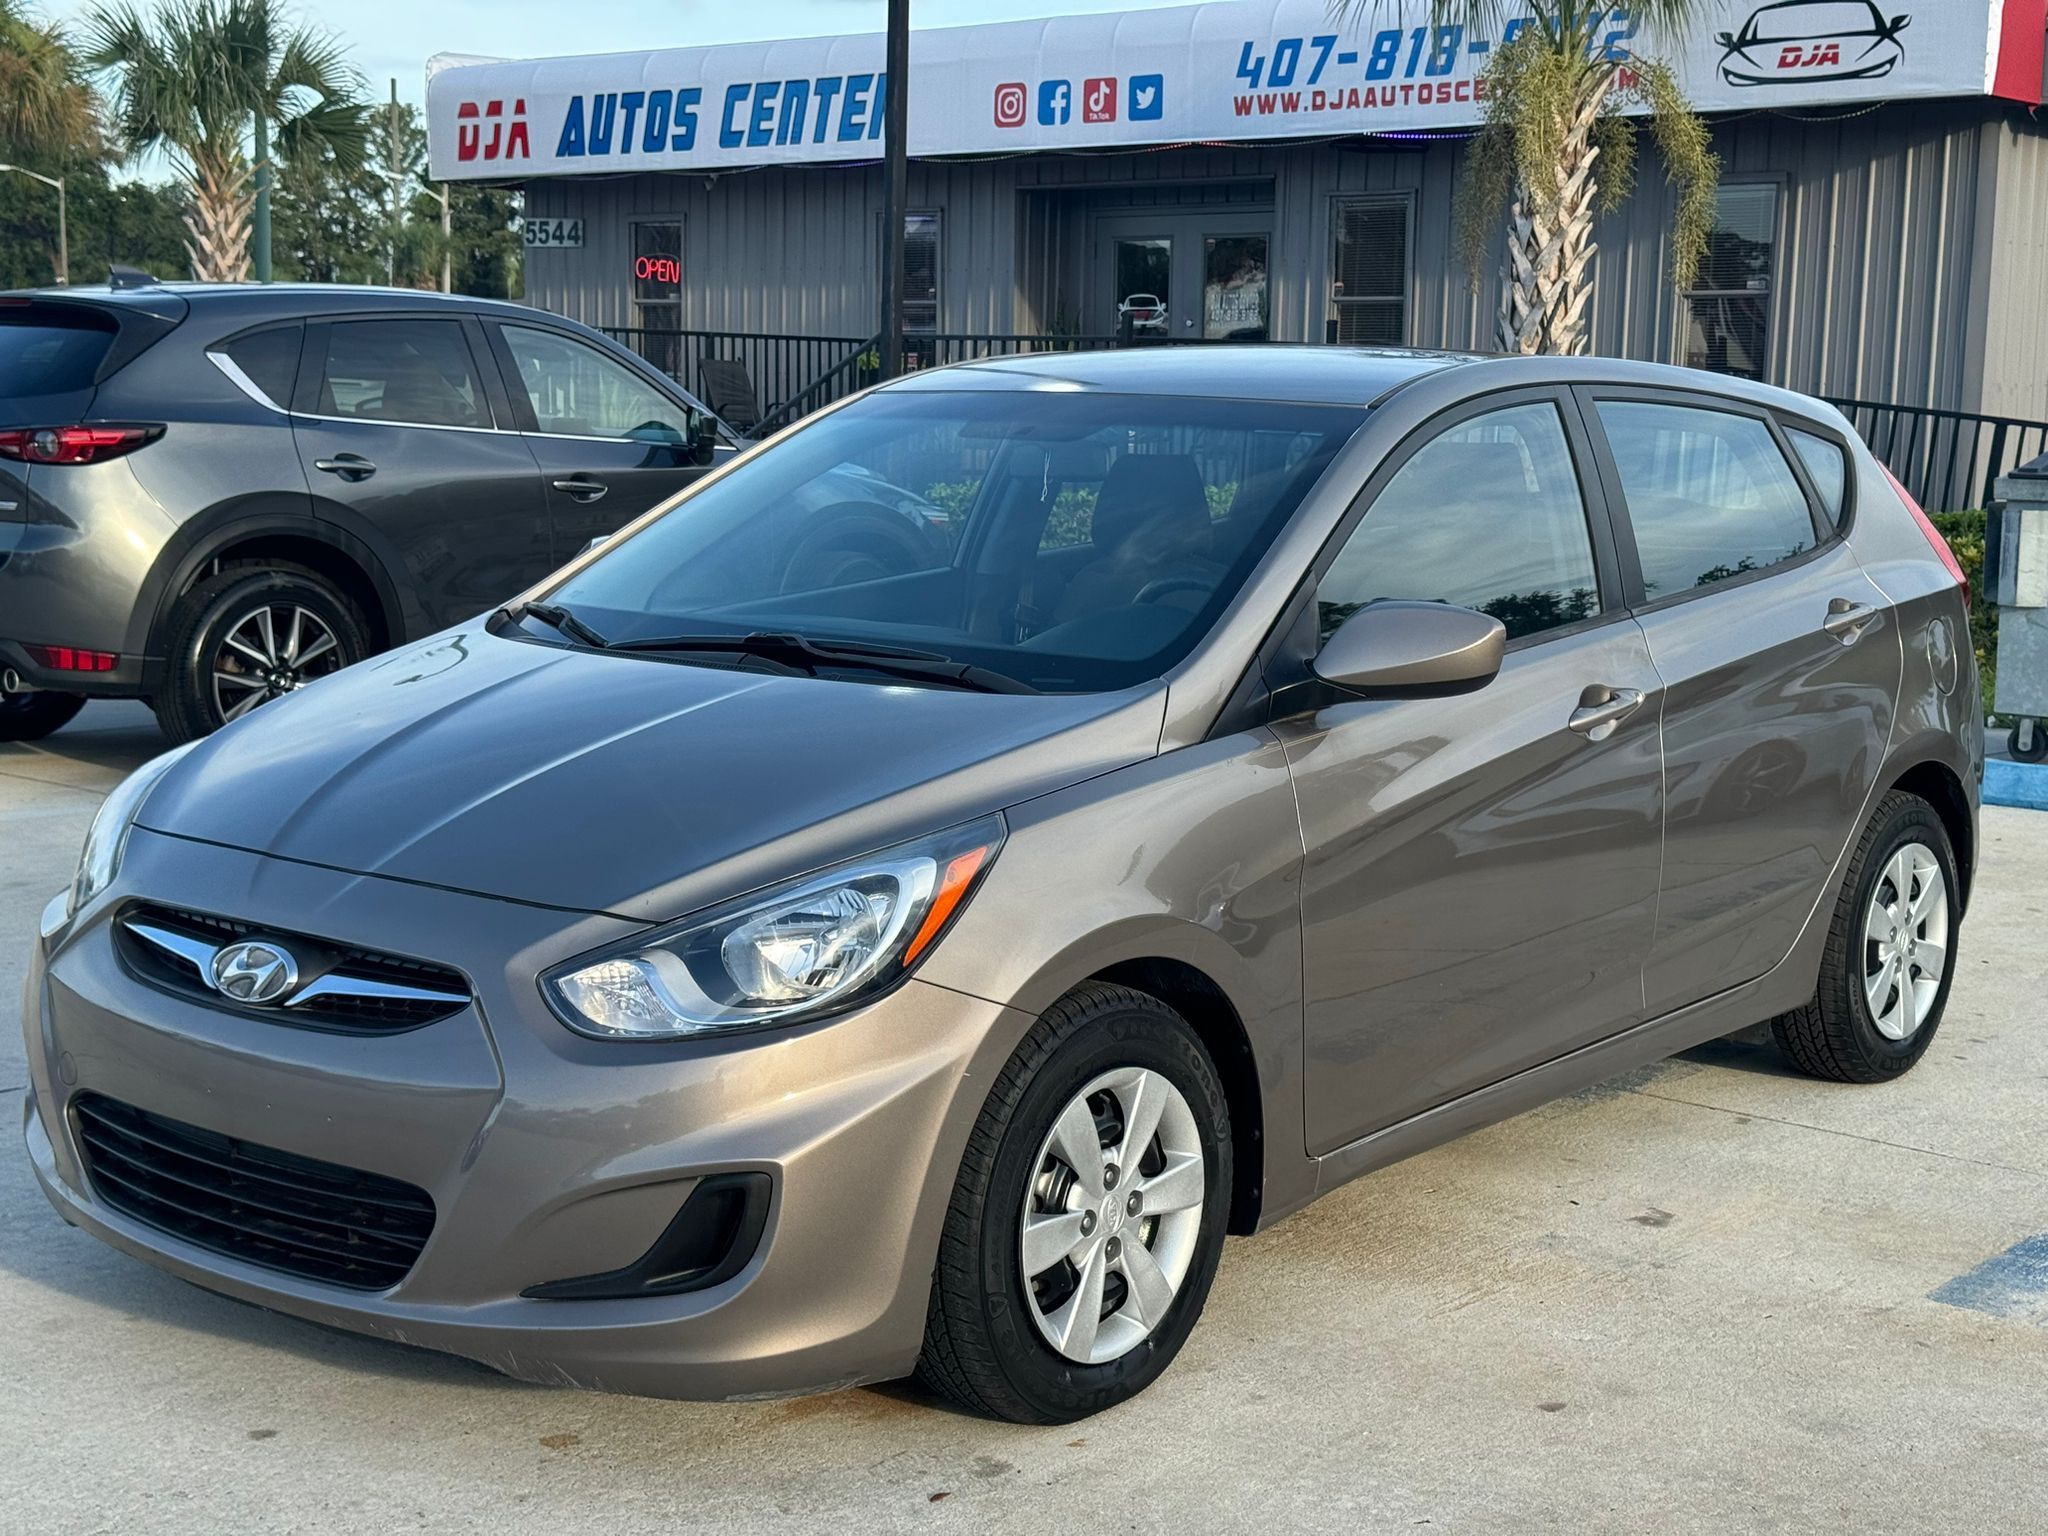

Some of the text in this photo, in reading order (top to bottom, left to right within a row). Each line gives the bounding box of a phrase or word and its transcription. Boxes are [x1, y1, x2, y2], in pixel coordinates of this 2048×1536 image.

[1236, 9, 1641, 89] 407-818-2
[1777, 44, 1840, 68] DJA
[458, 99, 530, 161] DJA
[556, 87, 702, 158] AUTOS
[525, 220, 581, 245] 5544
[635, 256, 680, 283] OPEN
